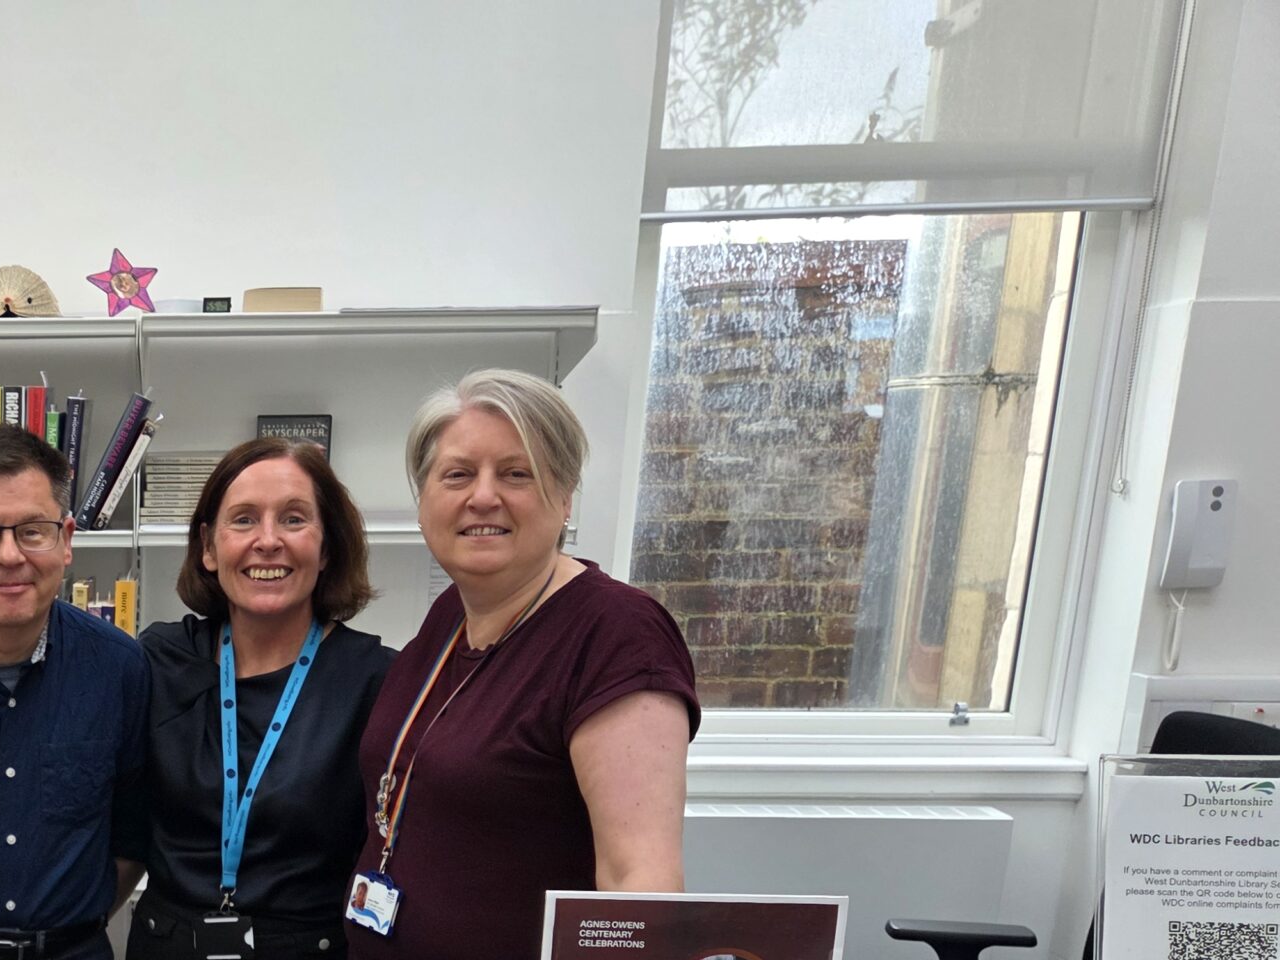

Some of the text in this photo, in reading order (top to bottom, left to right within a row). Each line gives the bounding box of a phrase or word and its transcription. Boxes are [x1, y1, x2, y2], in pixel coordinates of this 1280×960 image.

[6, 392, 18, 424] RiCHA
[70, 416, 78, 445] MIDNIGHT
[105, 399, 143, 469] BUYER BEWARE
[262, 428, 325, 438] SKYSCRAPER
[68, 448, 76, 465] TRAIN
[1204, 781, 1236, 794] West
[1184, 794, 1273, 807] Dunbartonshire
[1199, 809, 1263, 818] COUNCIL
[1130, 834, 1280, 848] WDC Libraries Feedbac
[1124, 866, 1129, 874] If
[1132, 868, 1147, 876] you
[1236, 870, 1277, 878] complaint
[580, 920, 645, 930] AGNES OWENS
[579, 930, 634, 938] CENTENARY
[578, 940, 645, 948] CELEBRATIONS
